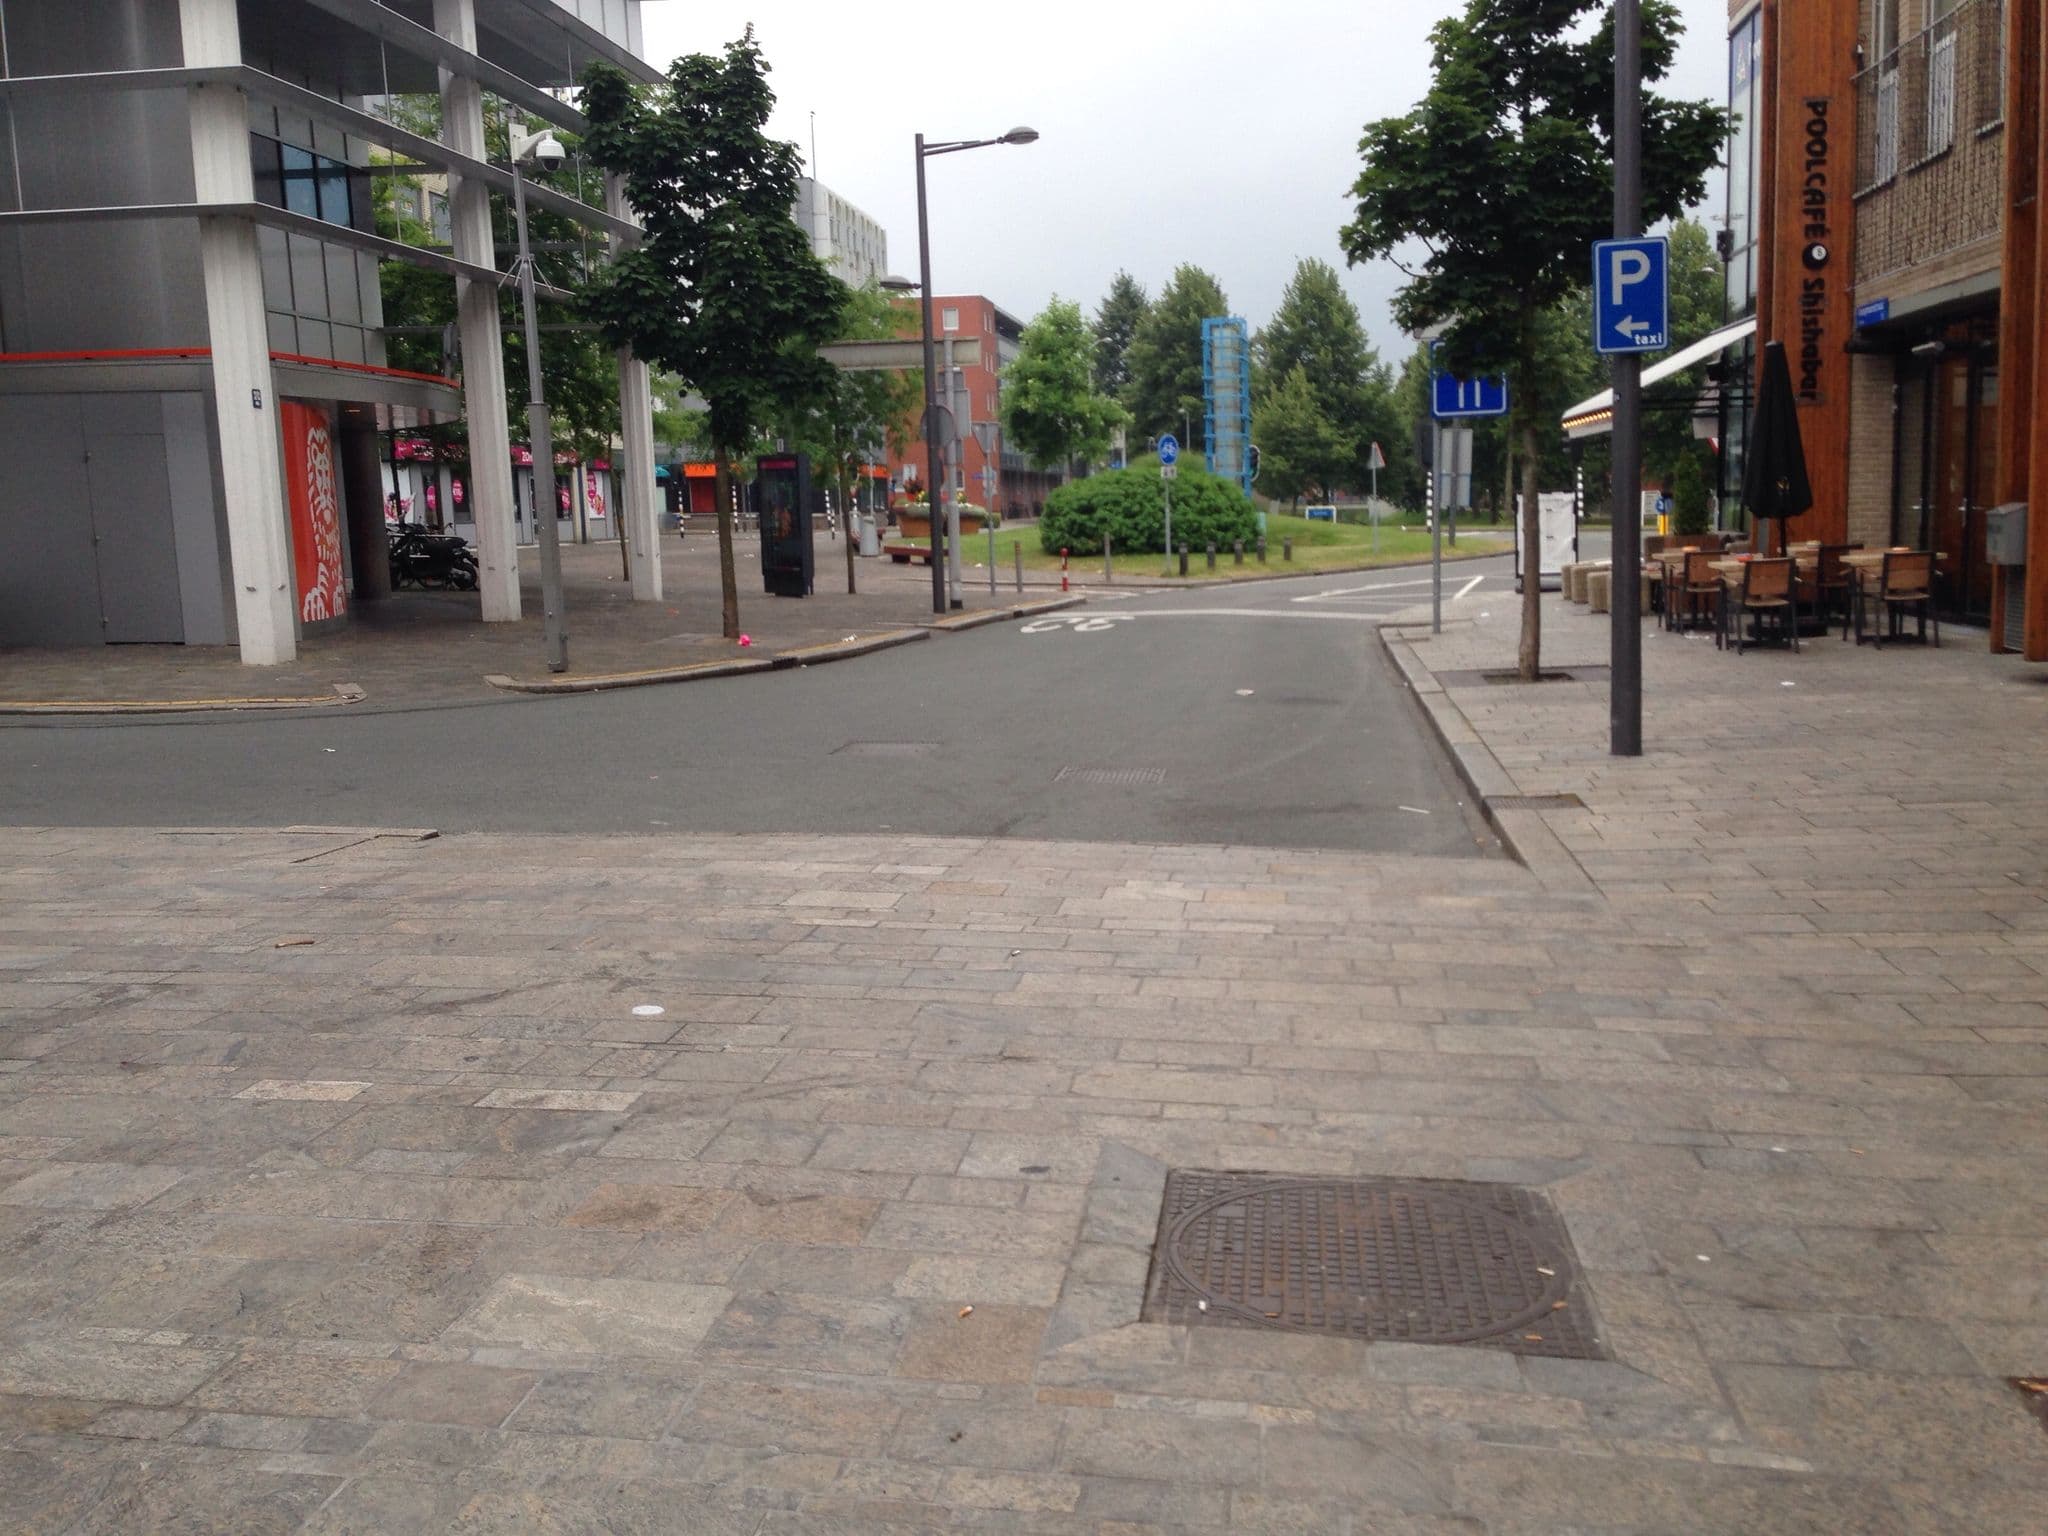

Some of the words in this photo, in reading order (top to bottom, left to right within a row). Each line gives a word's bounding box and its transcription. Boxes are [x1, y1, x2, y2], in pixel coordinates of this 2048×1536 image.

[1612, 249, 1651, 306] P
[1634, 332, 1663, 346] taxi
[1799, 278, 1825, 400] Shishabar
